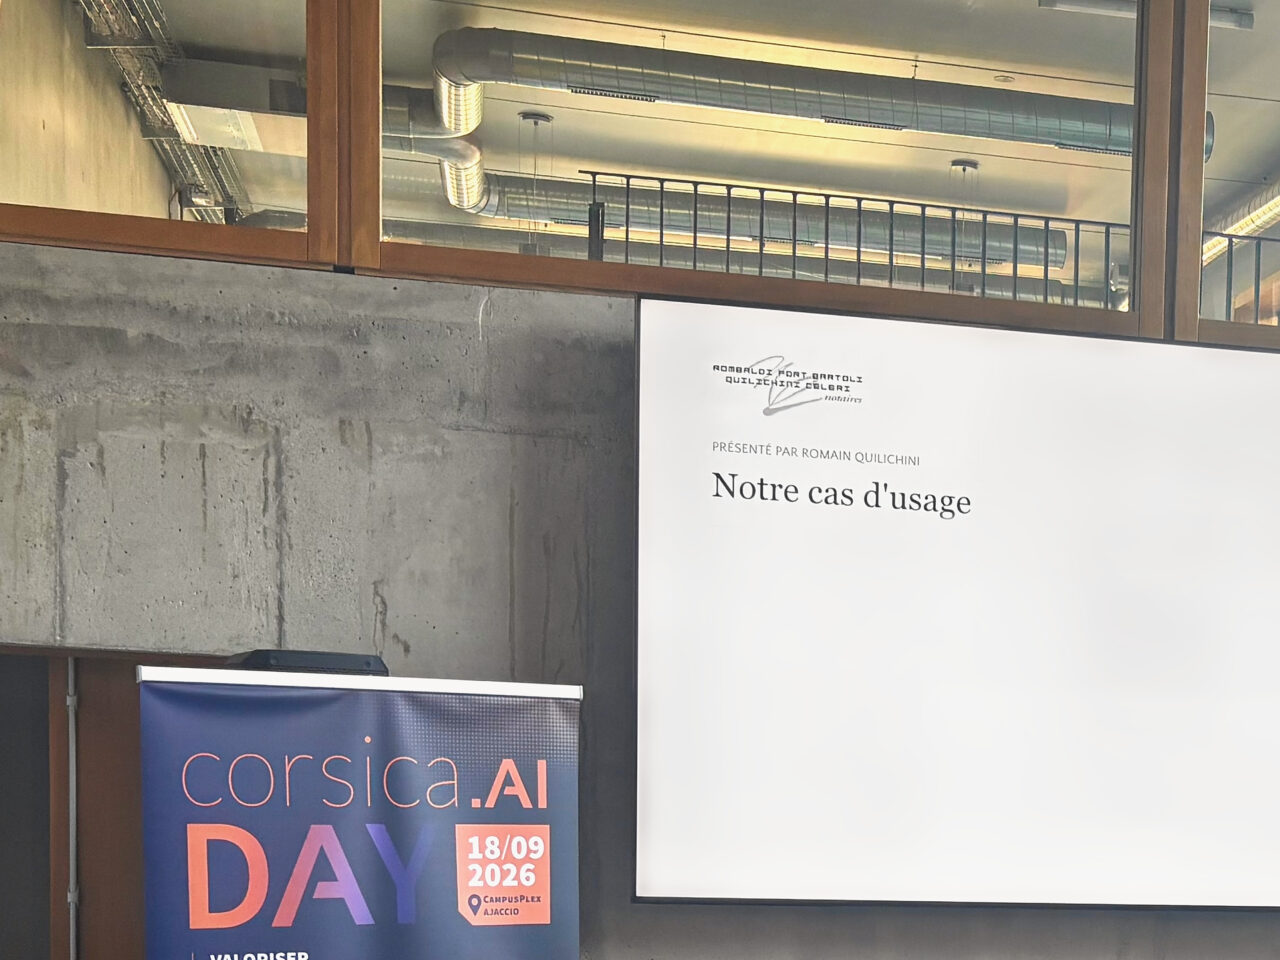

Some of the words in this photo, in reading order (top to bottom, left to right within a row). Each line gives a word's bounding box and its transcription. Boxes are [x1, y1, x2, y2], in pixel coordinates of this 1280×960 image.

[712, 364, 774, 377] ROMBALDI
[811, 371, 864, 384] BARTOLI
[725, 375, 802, 390] QUILICHINI
[712, 440, 773, 456] PRÉSENTÉ
[775, 445, 799, 457] PAR
[801, 448, 852, 462] ROMAIN
[854, 451, 921, 466] QUILICHINI
[711, 471, 800, 503] Notre
[807, 484, 854, 507] cas
[863, 481, 972, 520] d'usage
[467, 834, 545, 861] 18/09
[187, 823, 435, 930] DAY
[467, 863, 536, 887] 2026
[483, 908, 520, 917] AJACCIO
